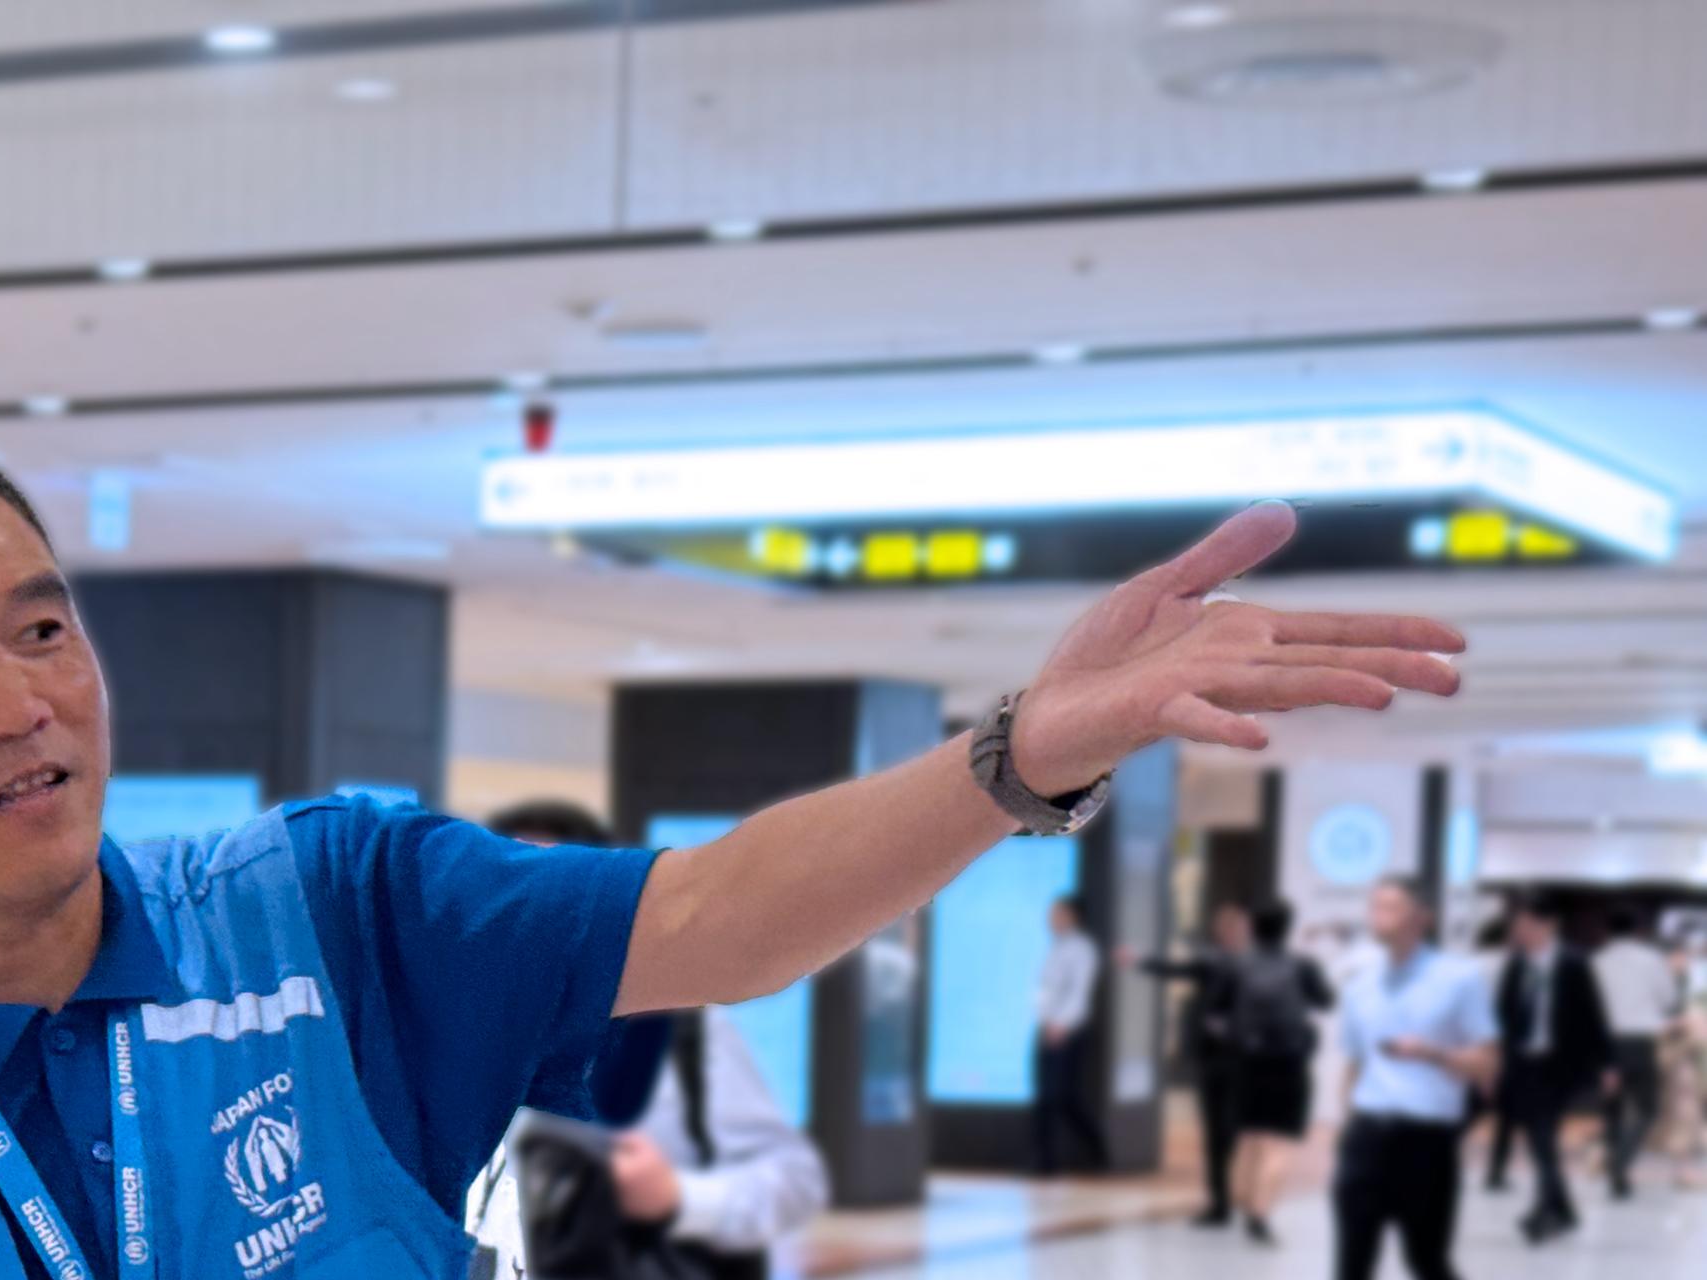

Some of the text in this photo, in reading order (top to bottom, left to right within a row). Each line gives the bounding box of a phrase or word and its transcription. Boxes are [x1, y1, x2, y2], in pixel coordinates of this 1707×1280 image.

[115, 1022, 132, 1085] UNHCR
[20, 1198, 65, 1264] UNHCR
[122, 1166, 141, 1233] UNHCR
